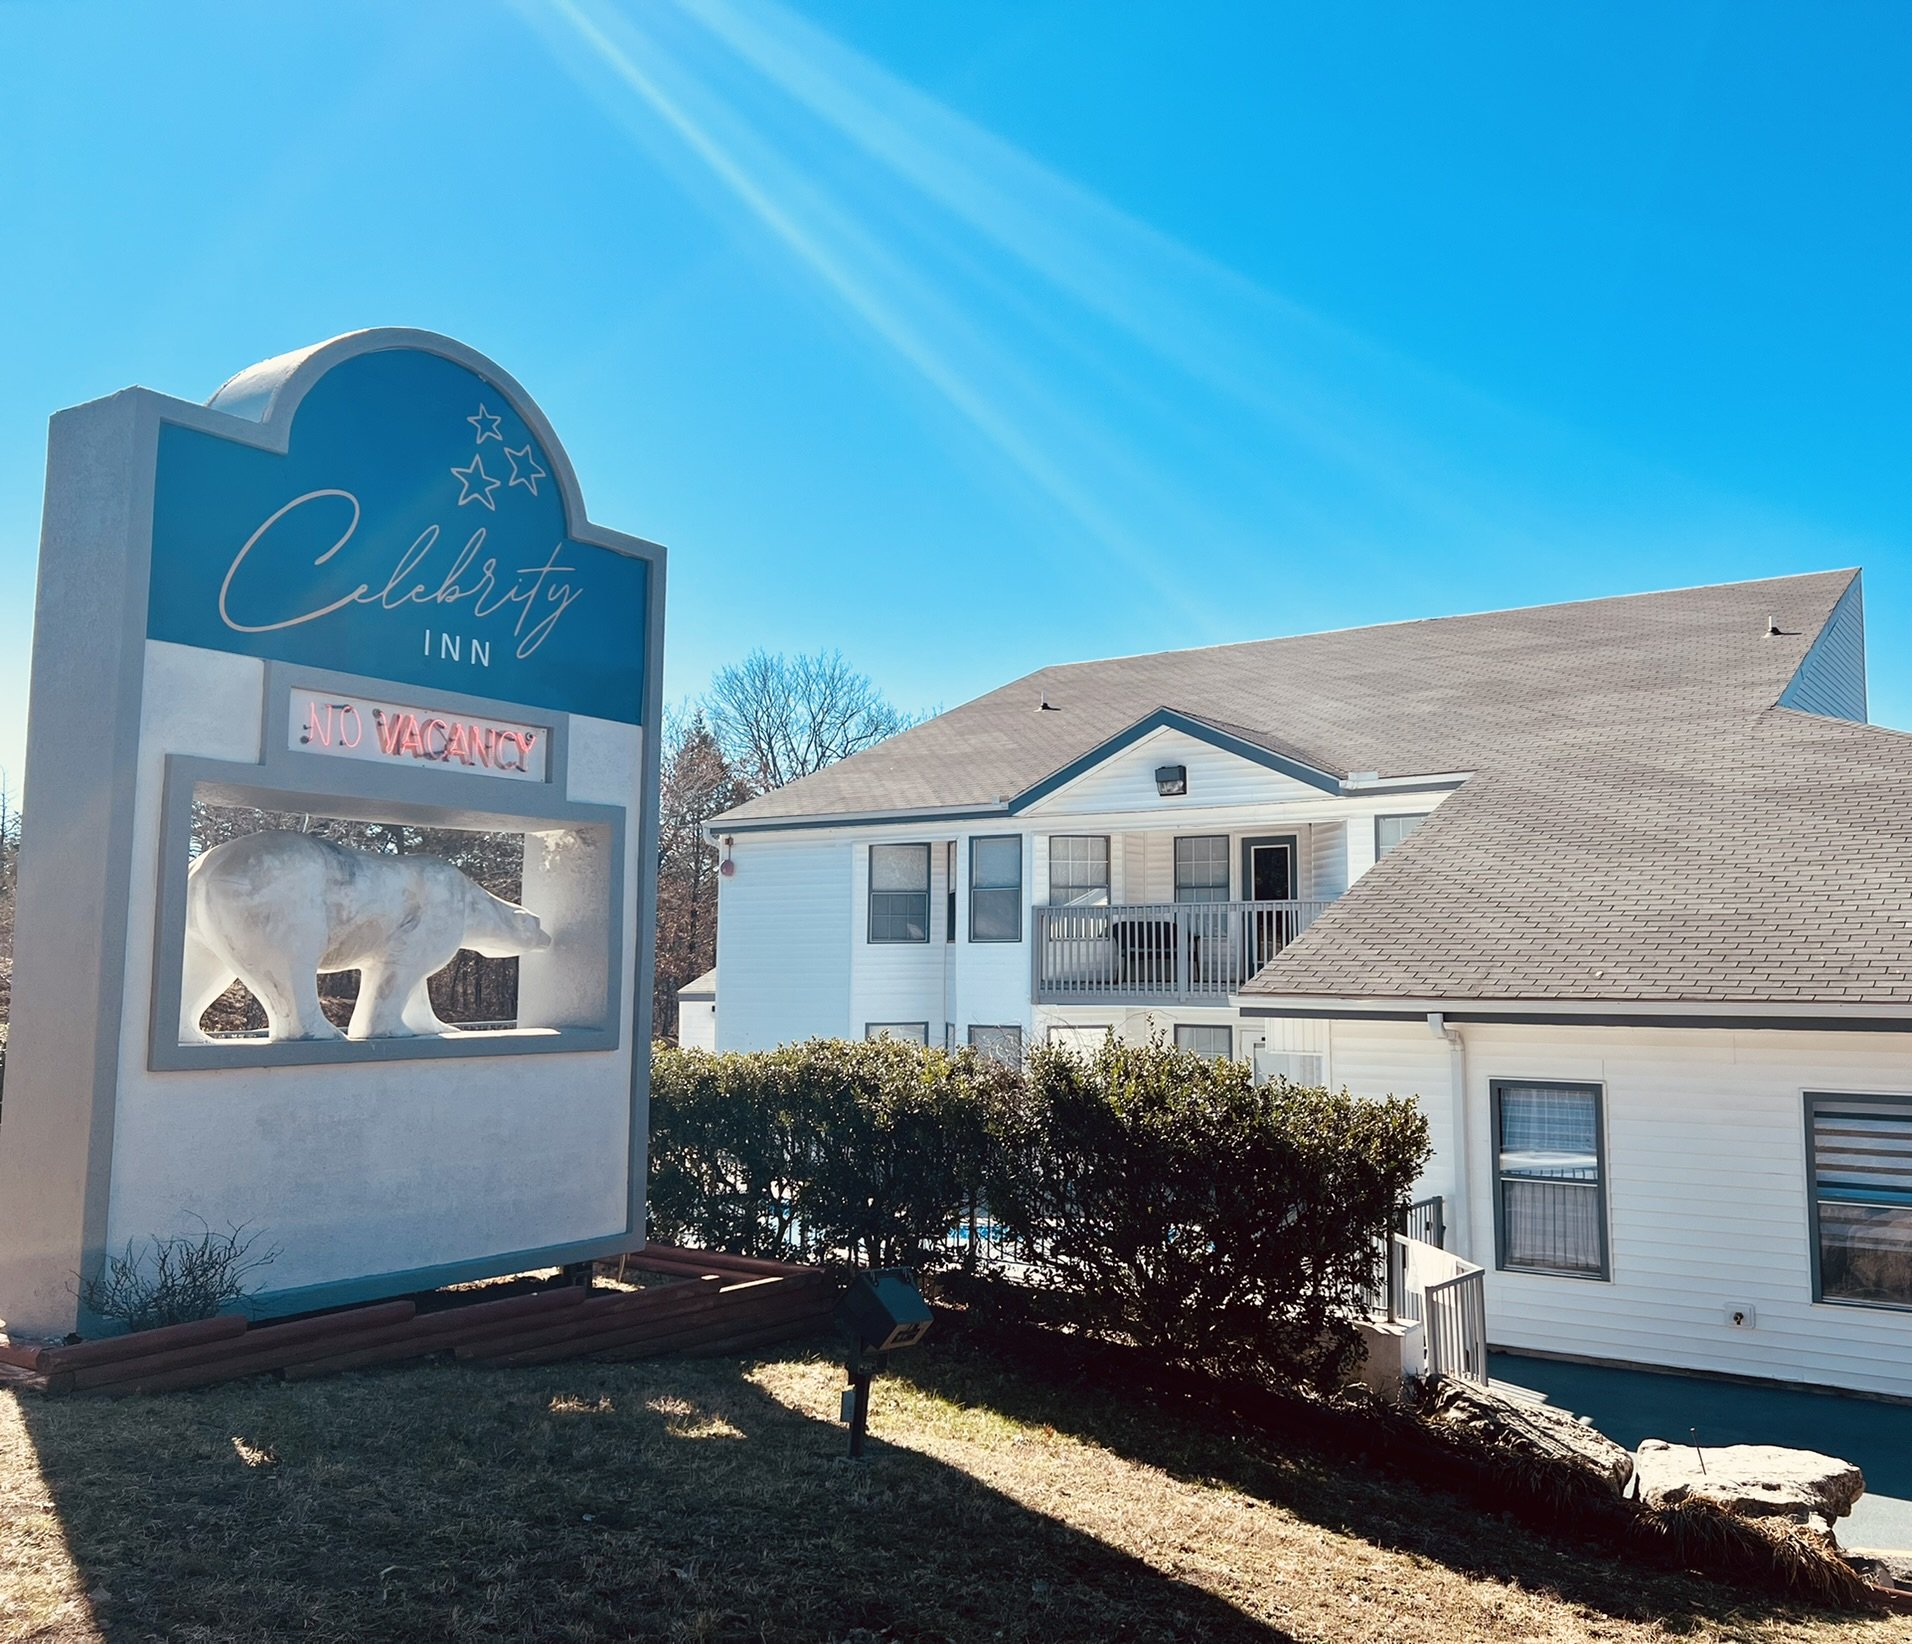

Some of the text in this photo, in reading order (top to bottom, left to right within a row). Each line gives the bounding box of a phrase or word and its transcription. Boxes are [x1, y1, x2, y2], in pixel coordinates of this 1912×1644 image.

[218, 488, 583, 659] Celebrity
[424, 629, 491, 667] INN
[307, 702, 536, 772] NO VACANCY
